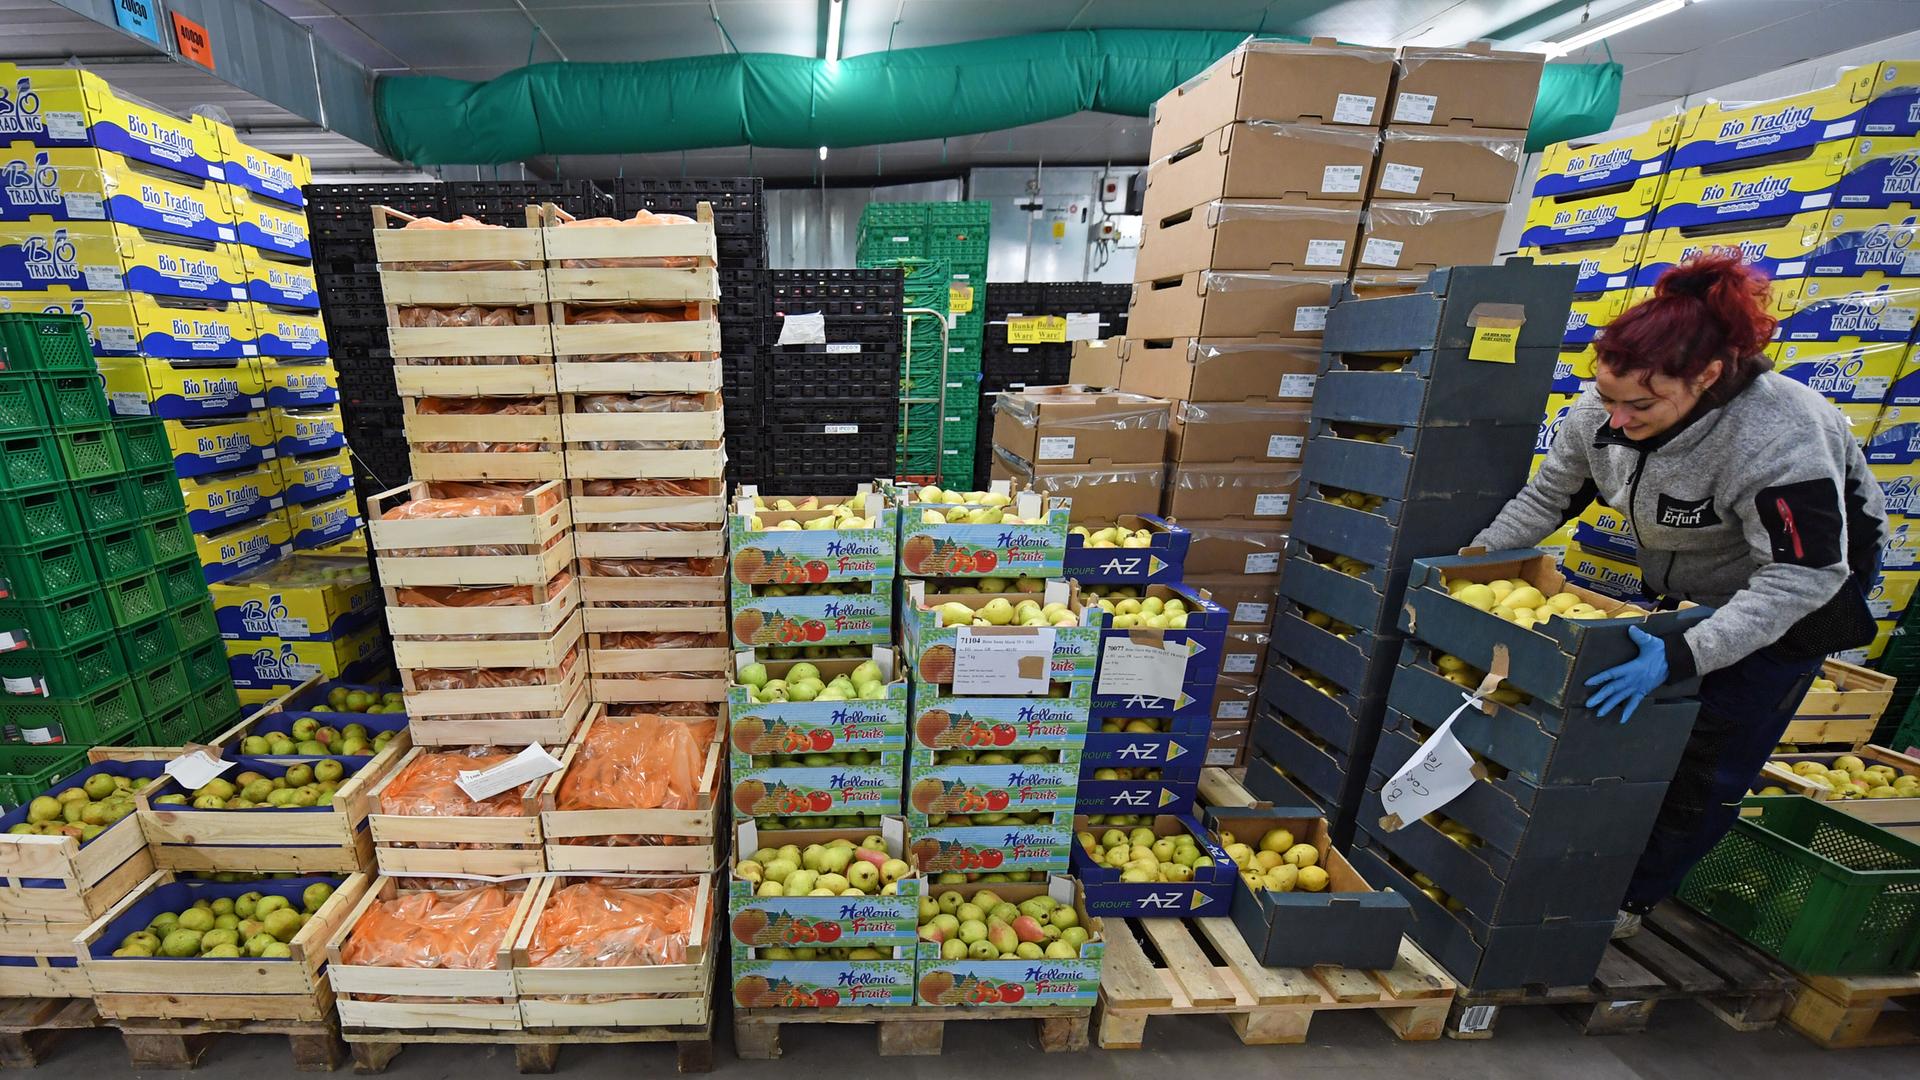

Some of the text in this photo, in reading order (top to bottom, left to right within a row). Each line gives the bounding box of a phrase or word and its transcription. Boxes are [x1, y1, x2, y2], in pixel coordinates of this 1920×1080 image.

[1720, 107, 1813, 138] Bio Trading
[129, 115, 148, 135] Bio
[152, 123, 193, 155] Trading
[1567, 148, 1632, 172] Bio Trading
[247, 156, 292, 188] Bio Trading
[1701, 176, 1791, 201] Bio Trading
[142, 186, 204, 218] Bio Trading
[1554, 205, 1617, 224] Bio Trading
[260, 215, 303, 241] Bio Trading
[159, 255, 218, 282] Bio Trading
[269, 271, 312, 292] Bio Trading
[173, 320, 230, 339] Bio Trading
[279, 324, 319, 340] Bio Trading
[184, 378, 238, 396] Bio Trading
[287, 374, 326, 388] Bio Trading
[296, 421, 334, 435] Bio Trading
[198, 433, 250, 451] Bio Trading
[304, 466, 341, 482] Bio Trading
[208, 486, 259, 507] Bio Trading
[312, 508, 348, 526] Bio Trading
[1597, 515, 1615, 529] Bio
[1661, 511, 1700, 526] Erfurt
[221, 535, 269, 560] Bio Trading
[997, 530, 1049, 548] Hellenic
[827, 539, 879, 557] Hellenic
[1007, 547, 1045, 565] Fruits
[837, 556, 875, 575] Fruits
[1100, 558, 1141, 575] AZ
[1578, 562, 1596, 575] Bio
[824, 602, 876, 618] Hellenic
[835, 616, 872, 633] Fruits
[1051, 659, 1074, 671] uits
[1122, 695, 1164, 708] AZ
[832, 708, 887, 725] Hellenic
[1018, 705, 1073, 722] Hellenic
[842, 725, 884, 742] Fruits
[1027, 721, 1067, 738] Fruits
[1116, 743, 1160, 759] AZ
[830, 773, 884, 789] Hellenic
[1008, 771, 1062, 787] Hellenic
[841, 788, 881, 805] Fruits
[1019, 787, 1057, 803] Fruits
[1110, 791, 1152, 806] AZ
[1003, 831, 1056, 847] Hellenic
[1013, 845, 1050, 862] Fruits
[1137, 892, 1183, 908] AZ
[840, 903, 900, 919] Hellenic
[852, 917, 895, 935] Fruits
[838, 970, 895, 986] Hellenic
[1025, 966, 1083, 982] Hellenic
[849, 984, 892, 1001] Fruits
[1036, 980, 1077, 996] Fruits
